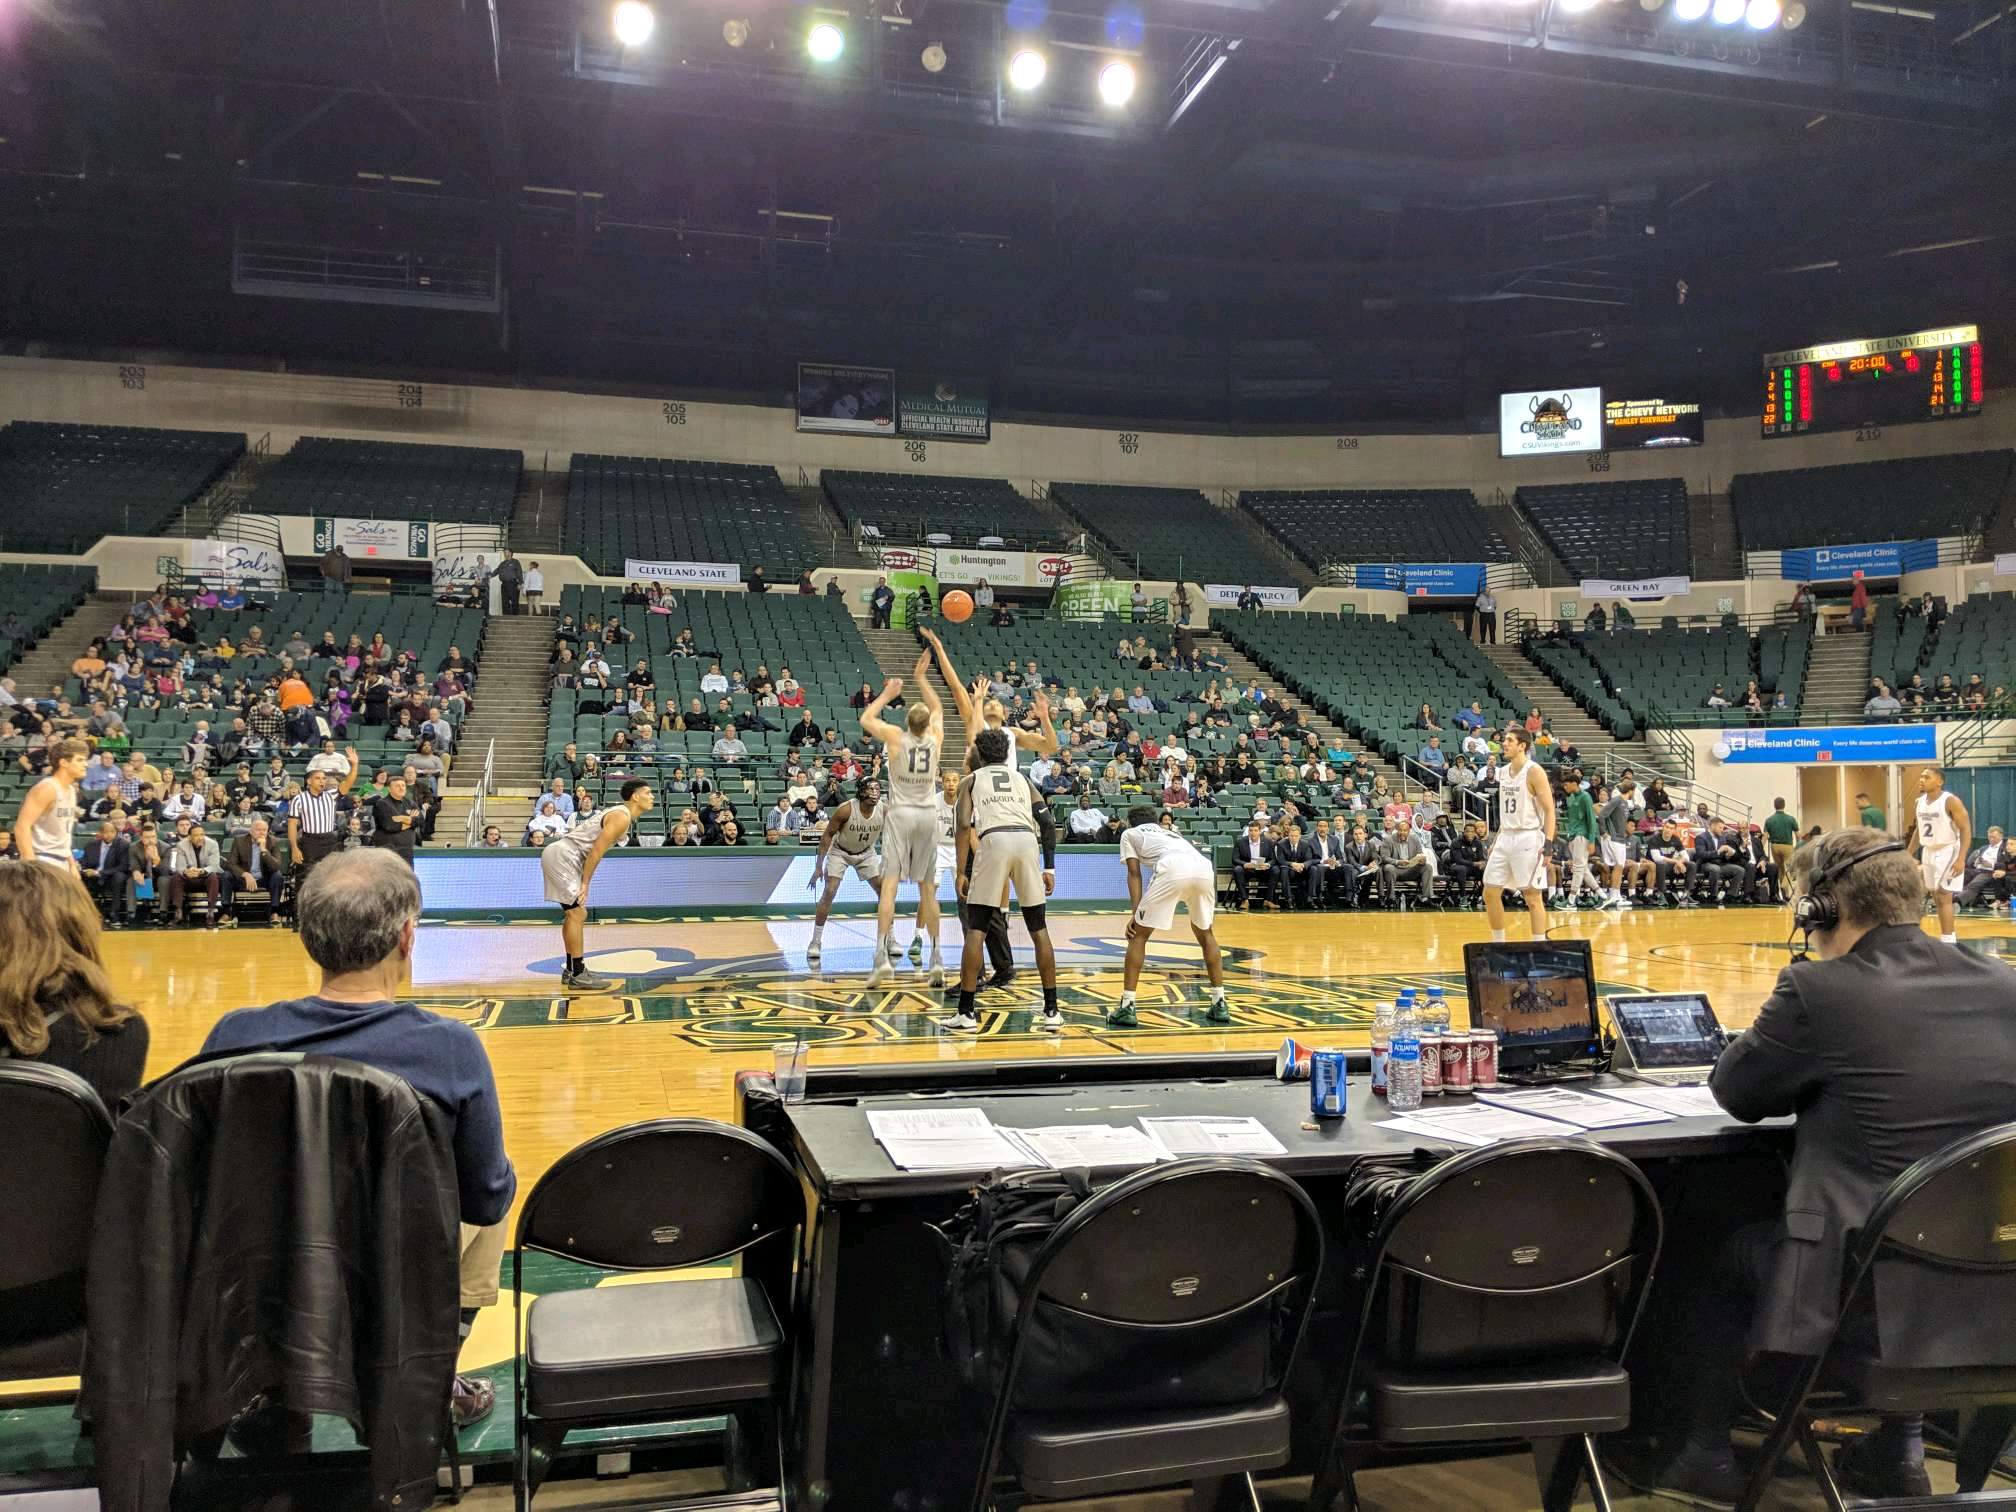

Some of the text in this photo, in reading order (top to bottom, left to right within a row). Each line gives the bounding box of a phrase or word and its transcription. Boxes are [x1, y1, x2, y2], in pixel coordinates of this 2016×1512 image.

[1888, 332, 1954, 348] UNIVERSITY
[1849, 356, 1885, 371] 20:00
[1935, 361, 1942, 370] 2
[119, 366, 146, 379] 203
[1933, 372, 1943, 382] 13
[122, 380, 145, 390] 103
[398, 384, 423, 395] 204
[1768, 382, 1775, 391] 2
[400, 397, 423, 408] 104
[663, 402, 686, 414] 205
[900, 400, 985, 415] MEDICAL MUTUAL
[1606, 403, 1699, 418] THE CHEVY NETWORK
[665, 415, 686, 425] 105
[901, 414, 928, 423] OFFICIAL
[929, 416, 950, 424] HEALTH
[1640, 415, 1677, 424] CHEVROLET
[1763, 414, 1776, 424] 22
[901, 421, 986, 434] CLEVELAND STATE ATHLETICS
[1520, 417, 1582, 434] CLEVELAND
[1119, 433, 1139, 443] 207
[1856, 428, 1881, 441] 210
[904, 441, 926, 451] 206
[1121, 444, 1139, 454] 107
[1336, 438, 1358, 449] 208
[1521, 440, 1581, 449] CSUVikings.com
[1586, 452, 1610, 462] 209
[1590, 463, 1610, 473] 109
[356, 521, 385, 535] Sal's
[315, 533, 325, 549] GO
[325, 520, 334, 552] VIKINGS!
[409, 525, 418, 557] VIKINGS!
[418, 528, 427, 543] GO
[1832, 547, 1898, 560] Cleveland Clinic
[225, 546, 270, 573] Sal's
[961, 555, 1007, 567] Huntington
[434, 557, 466, 584] Sal's
[639, 566, 727, 578] CLEVELAND STATE
[1398, 569, 1433, 577] Ceveland
[988, 574, 1021, 582] VIKINGS!
[1610, 583, 1660, 592] GREEN BAY
[1258, 592, 1285, 600] MERCY
[1060, 597, 1120, 617] GREEN
[1562, 609, 1577, 617] 109
[1748, 738, 1821, 749] Cleveland Clinic
[908, 747, 931, 773] 13
[990, 770, 1012, 793] 2
[982, 796, 1015, 807] MADDOX
[1505, 799, 1517, 814] 13
[849, 823, 881, 833] OAKLAND
[946, 827, 953, 839] 4
[1923, 823, 1933, 837] 2
[858, 833, 869, 842] 14
[1394, 1043, 1419, 1051] AQUAFINA
